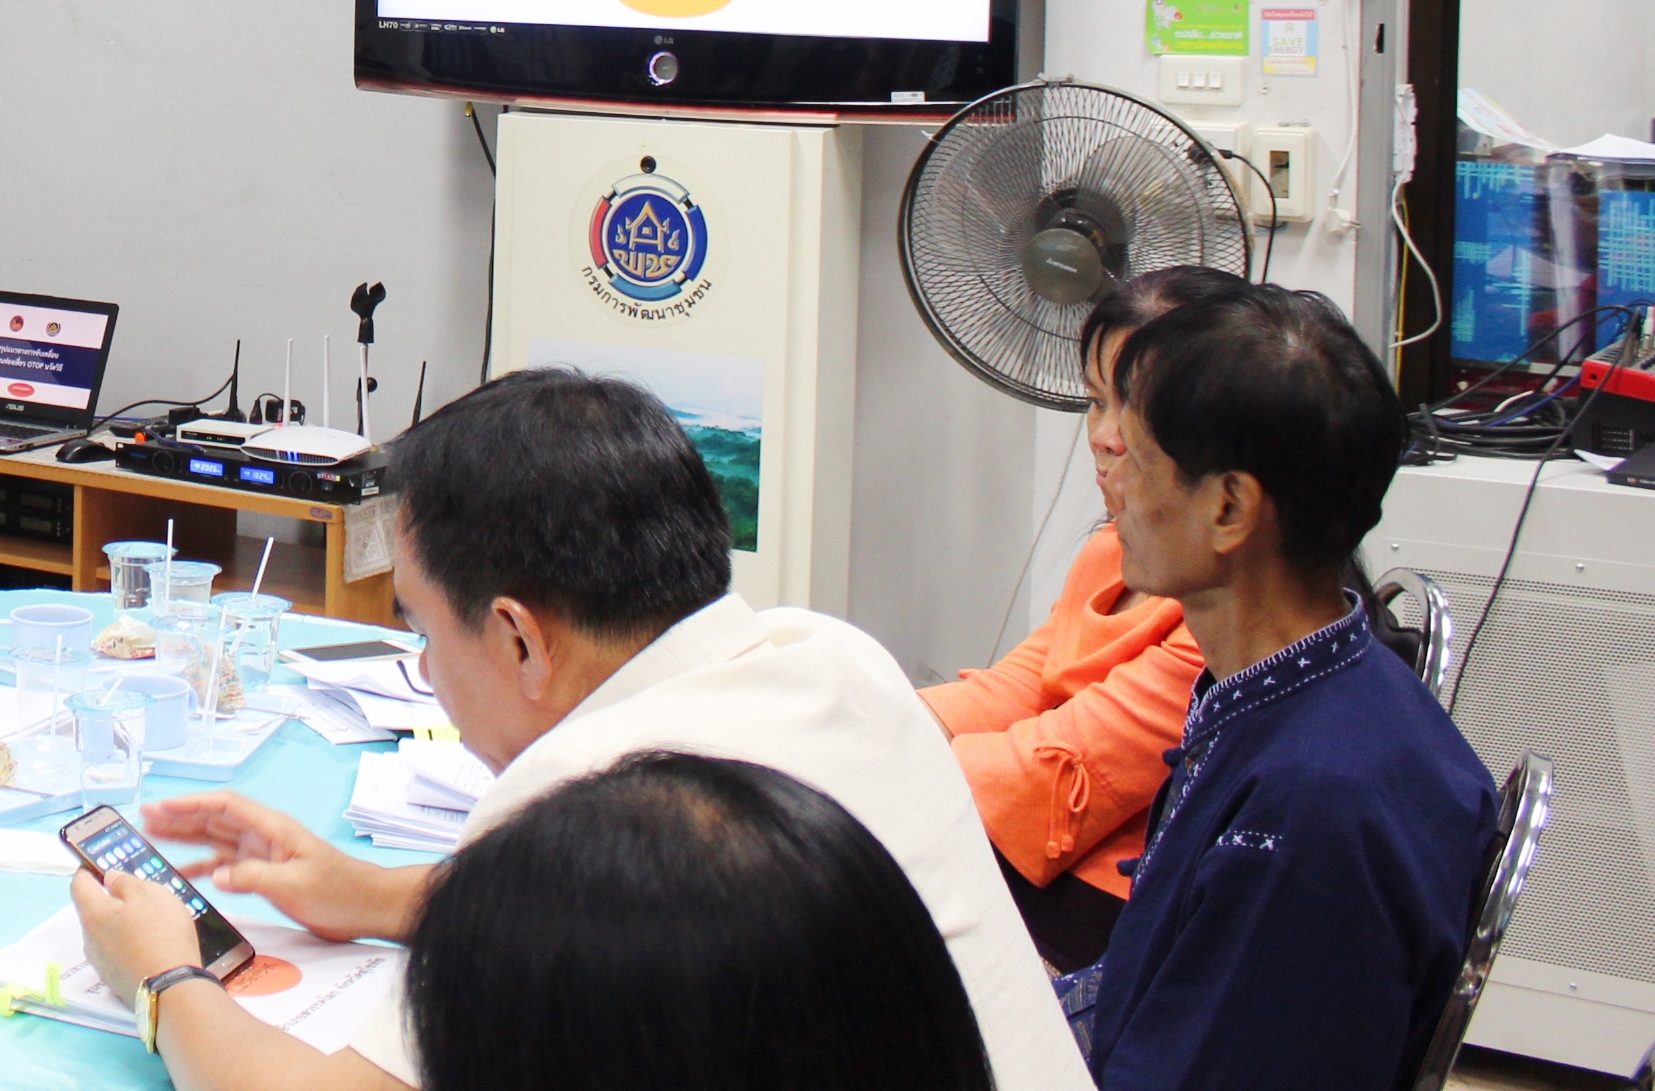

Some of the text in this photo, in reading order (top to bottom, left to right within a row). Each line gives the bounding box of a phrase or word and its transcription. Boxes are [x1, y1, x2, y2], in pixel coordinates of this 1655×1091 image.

[378, 20, 399, 29] LH70
[1272, 37, 1304, 47] SAVE
[581, 266, 713, 321] กรมการพัฒนาชุมชน
[26, 361, 44, 369] OTOP
